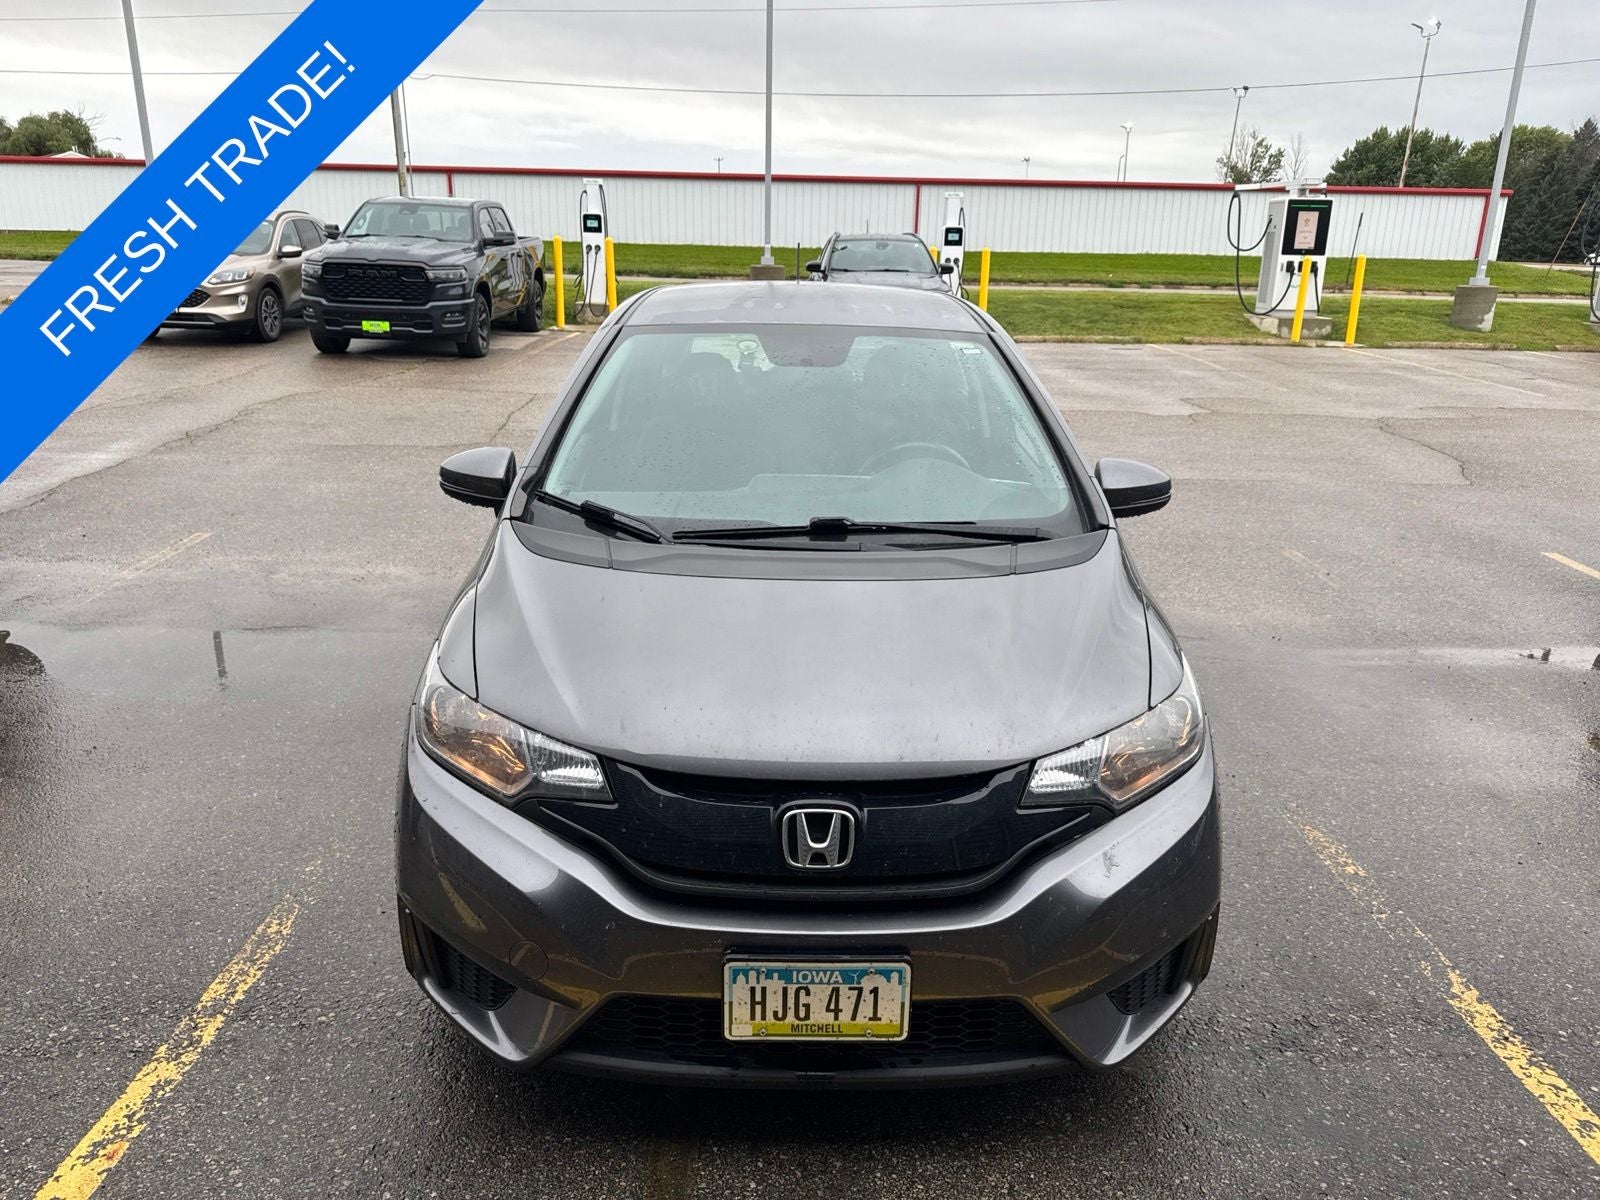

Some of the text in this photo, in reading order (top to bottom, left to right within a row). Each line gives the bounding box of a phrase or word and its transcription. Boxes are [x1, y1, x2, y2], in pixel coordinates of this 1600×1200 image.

[792, 970, 844, 984] IOWA
[749, 986, 882, 1021] HJG 471
[790, 1024, 844, 1034] MITCHELL
